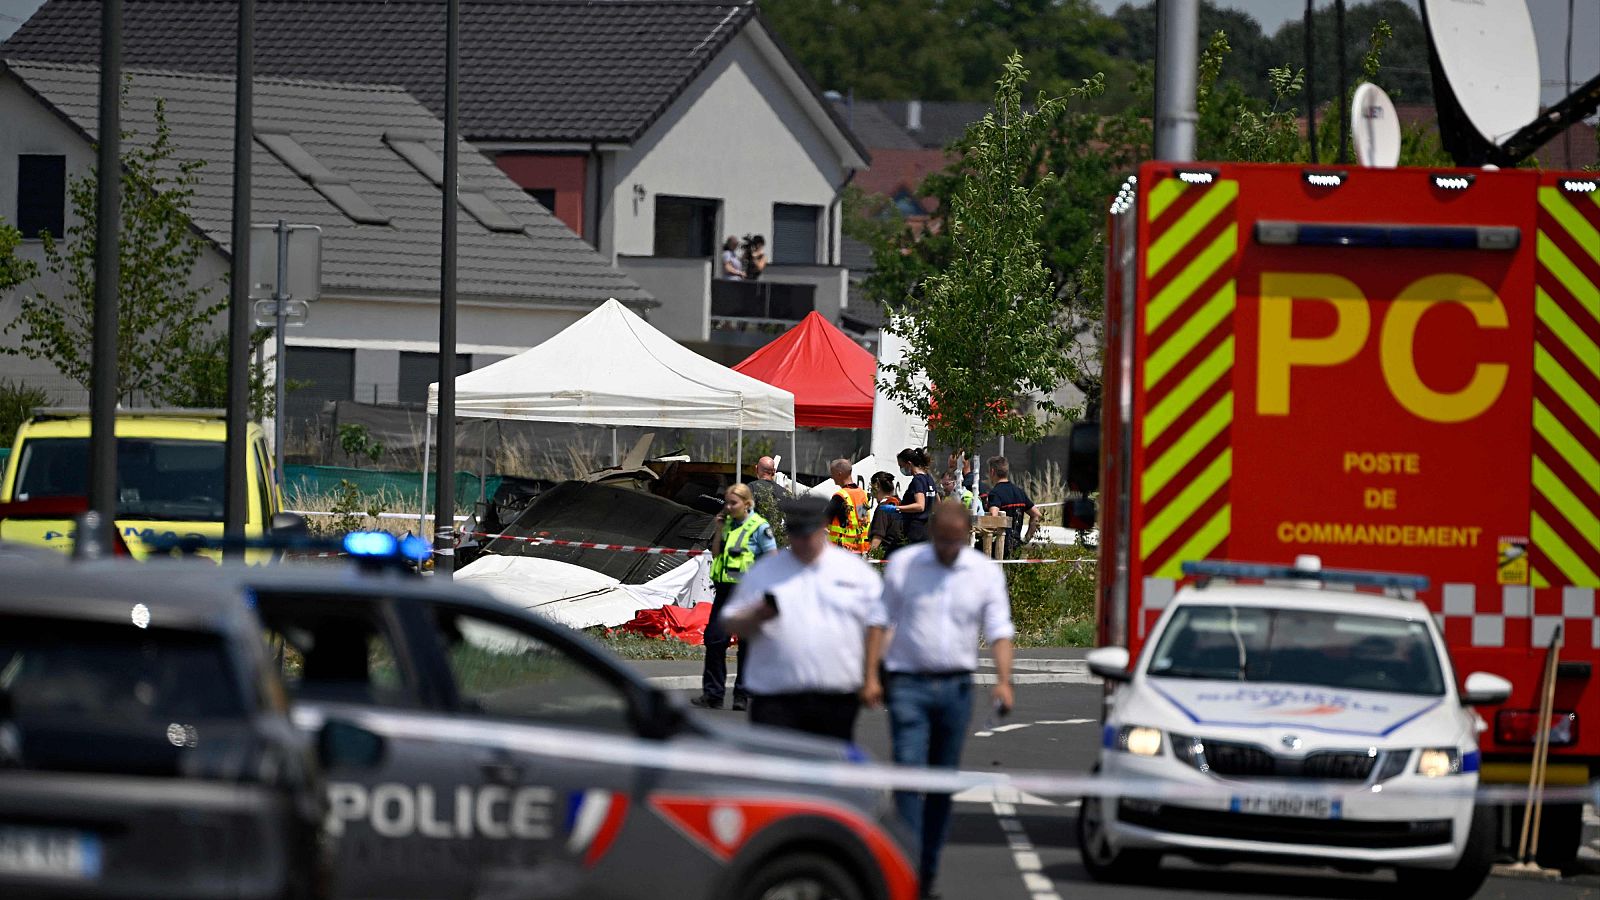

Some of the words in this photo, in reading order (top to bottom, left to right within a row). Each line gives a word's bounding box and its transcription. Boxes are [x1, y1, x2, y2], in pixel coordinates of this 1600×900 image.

[1256, 271, 1510, 424] PC
[1343, 451, 1420, 474] POSTE
[1363, 487, 1397, 510] DE
[1276, 521, 1482, 548] COMMANDEMENT
[325, 781, 556, 839] POLICE
